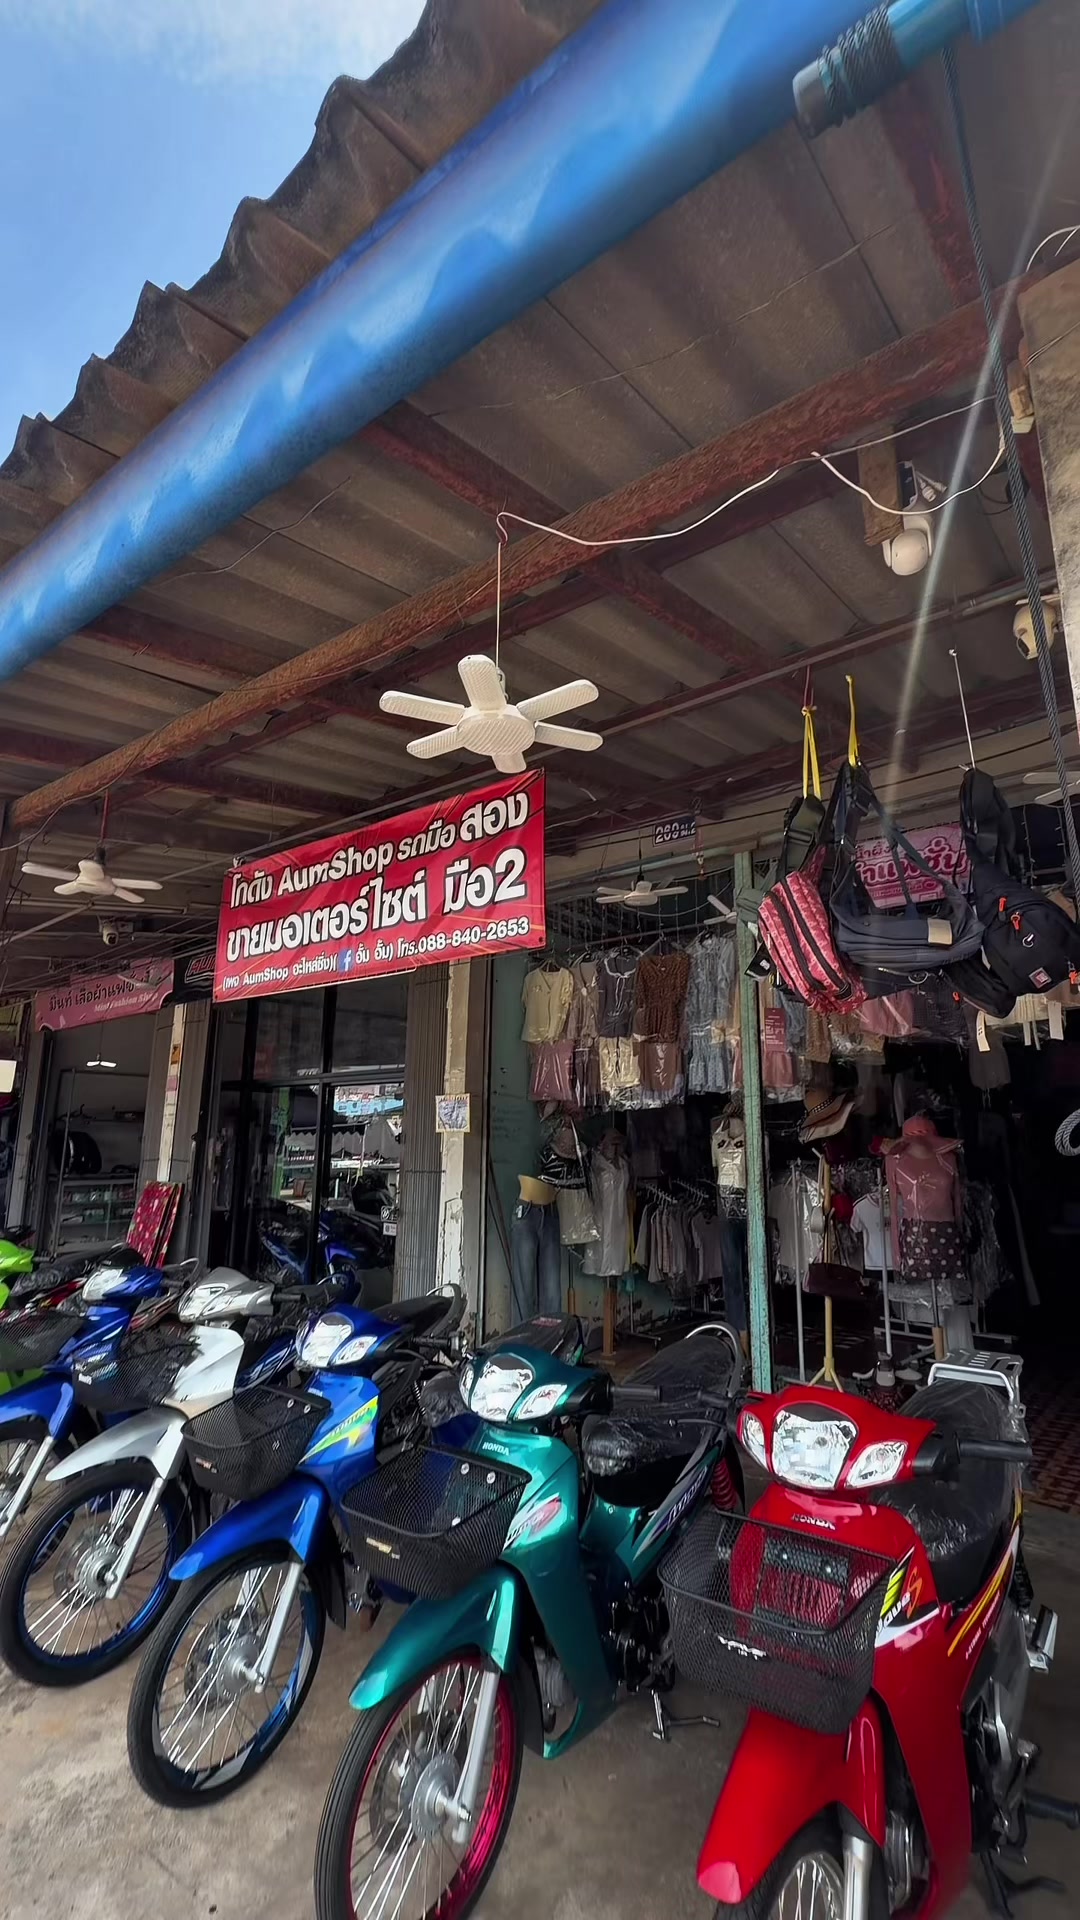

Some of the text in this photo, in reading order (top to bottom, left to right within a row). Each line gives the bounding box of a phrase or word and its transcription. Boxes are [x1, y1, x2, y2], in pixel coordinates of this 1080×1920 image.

[229, 871, 273, 909] โกดัง
[277, 843, 393, 896] AumShop
[459, 792, 529, 842] สอง
[242, 964, 289, 986] AumShop
[482, 1441, 510, 1457] HONDA
